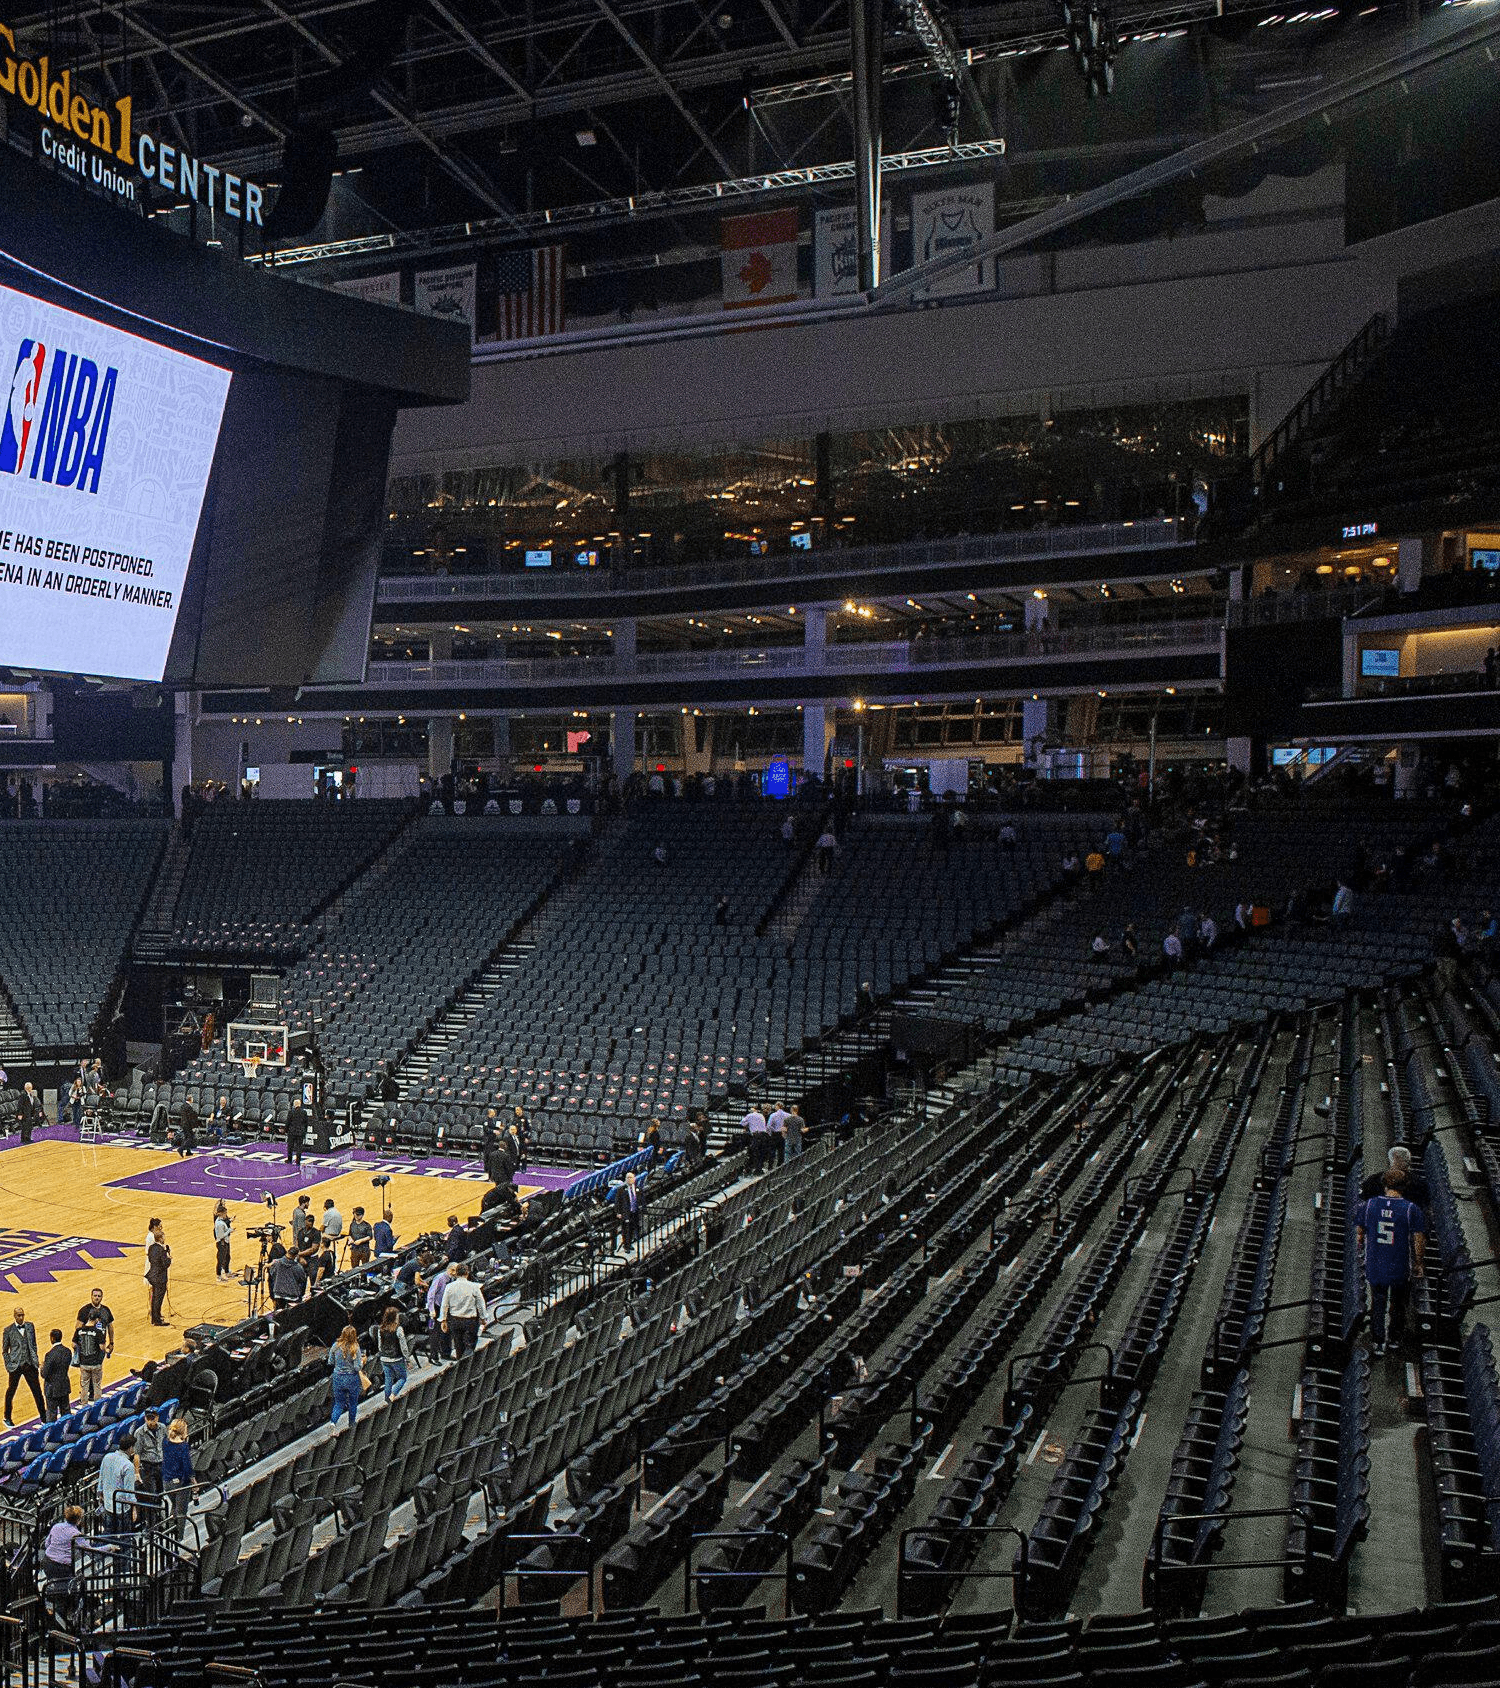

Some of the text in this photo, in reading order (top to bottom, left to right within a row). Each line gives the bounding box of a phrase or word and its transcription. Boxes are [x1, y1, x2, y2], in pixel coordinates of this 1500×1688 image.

[41, 127, 136, 201] Credit Union
[138, 133, 264, 226] CENTER
[30, 348, 117, 495] NBA
[13, 533, 44, 557] HAS
[44, 539, 81, 564] BEEN
[81, 546, 155, 578] POSTPONED.
[26, 567, 43, 588] IN
[43, 570, 64, 591] AN
[64, 574, 123, 600] ORDERLY
[122, 583, 174, 609] MANNER.
[107, 1138, 491, 1182] SARAMENTO
[1376, 1220, 1396, 1245] 5
